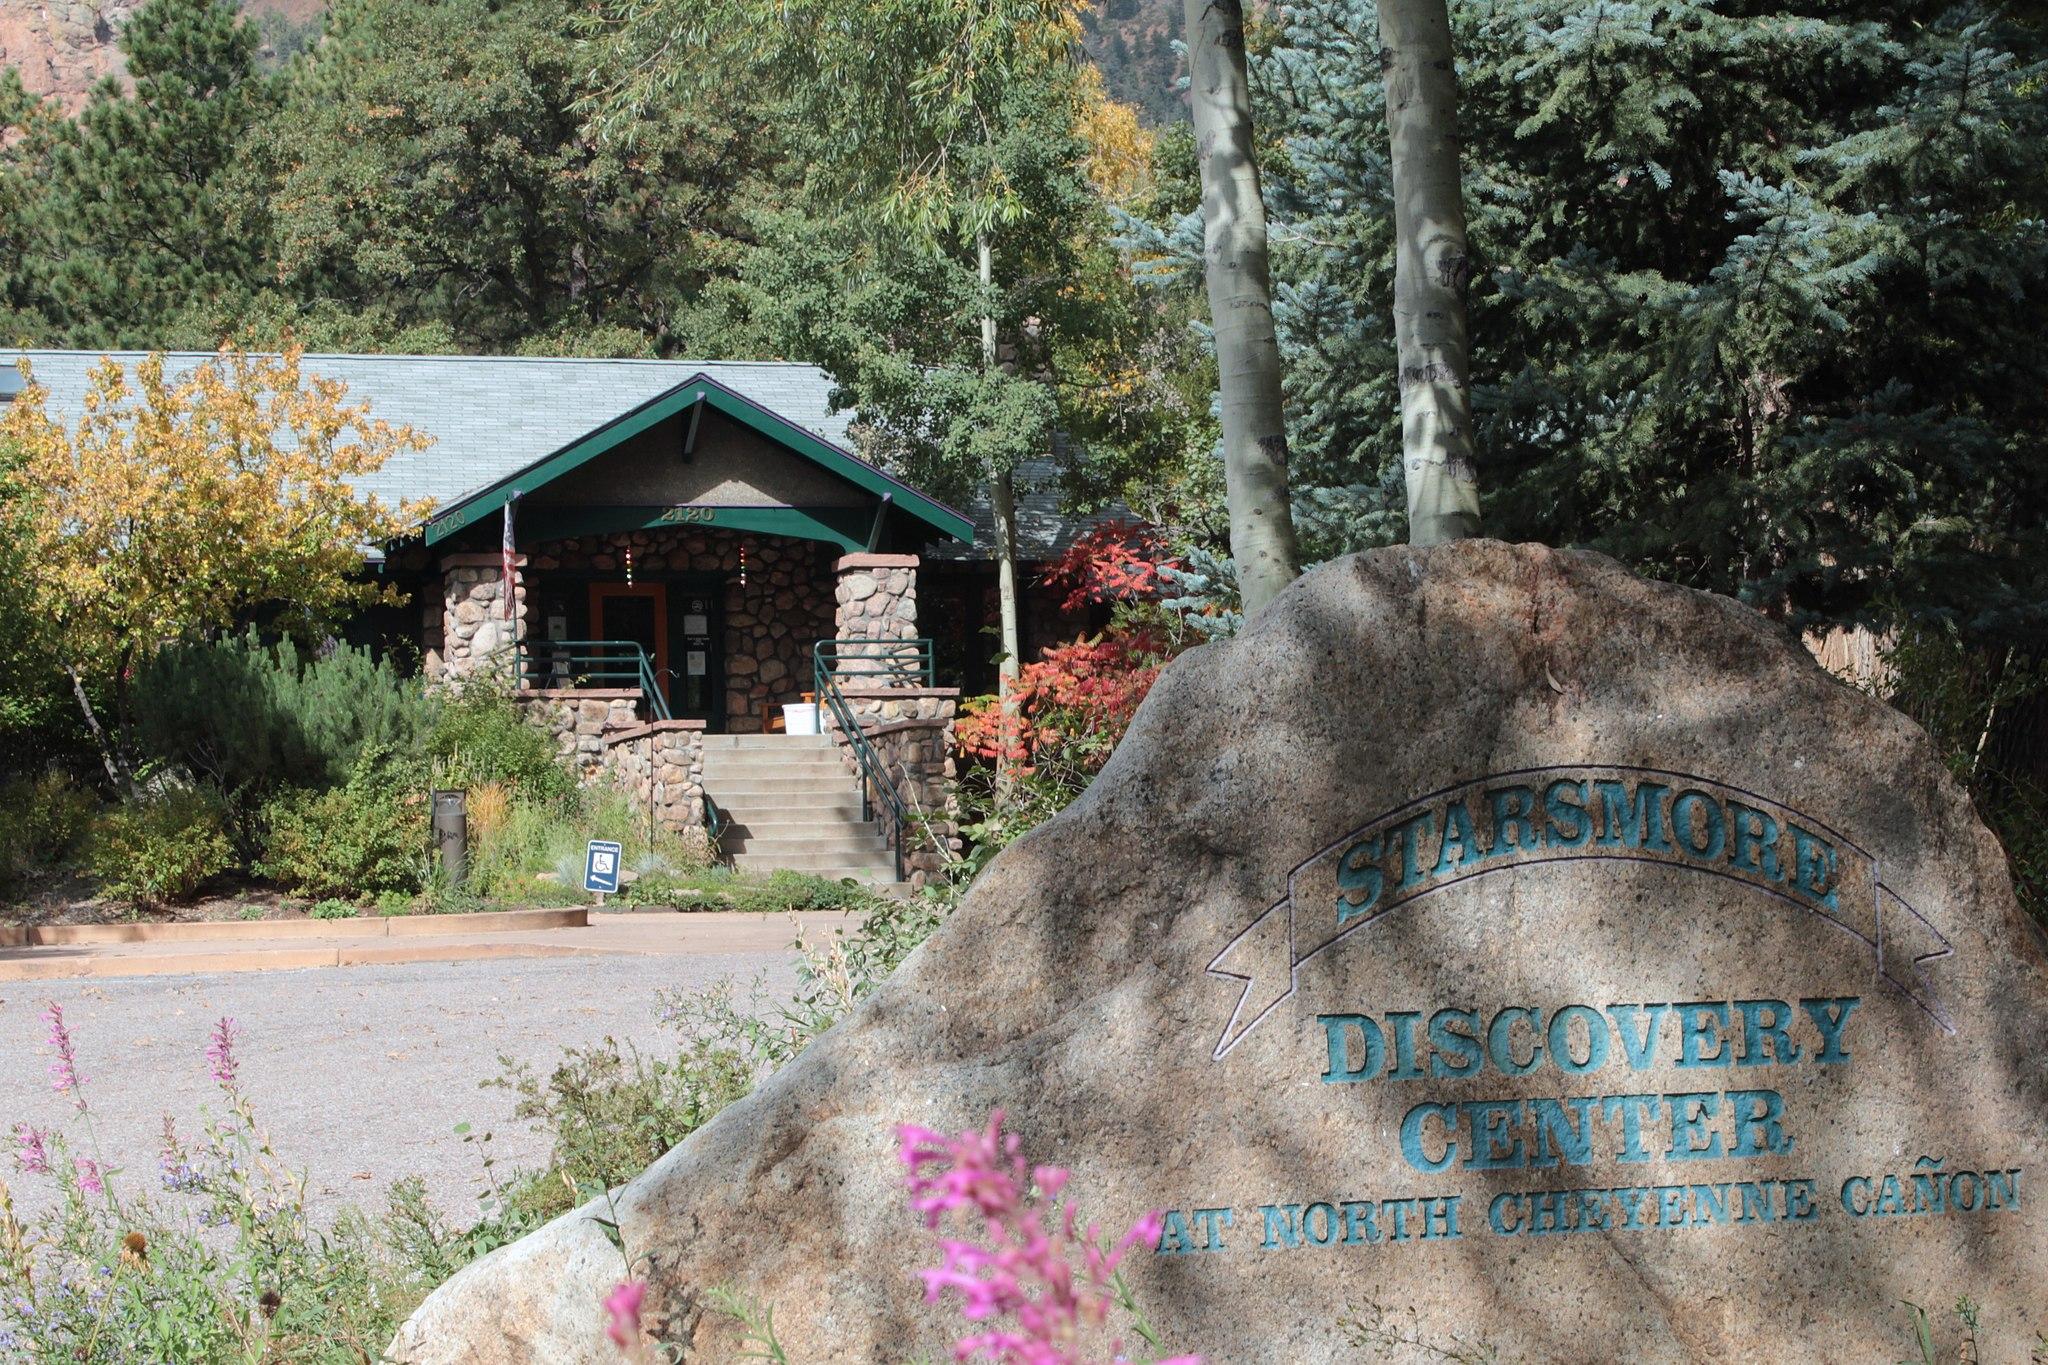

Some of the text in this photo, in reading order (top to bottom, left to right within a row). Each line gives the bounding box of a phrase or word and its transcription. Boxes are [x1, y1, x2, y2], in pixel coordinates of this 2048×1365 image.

[661, 506, 715, 522] 2120
[590, 844, 619, 853] ENTRANCE
[1335, 778, 1839, 925] STARSMORE
[1317, 996, 1860, 1084] DISCOVERY
[1400, 1089, 1795, 1175] CENTER
[1154, 1154, 2022, 1255] AT NORTH CHEYENNE CAÑON
